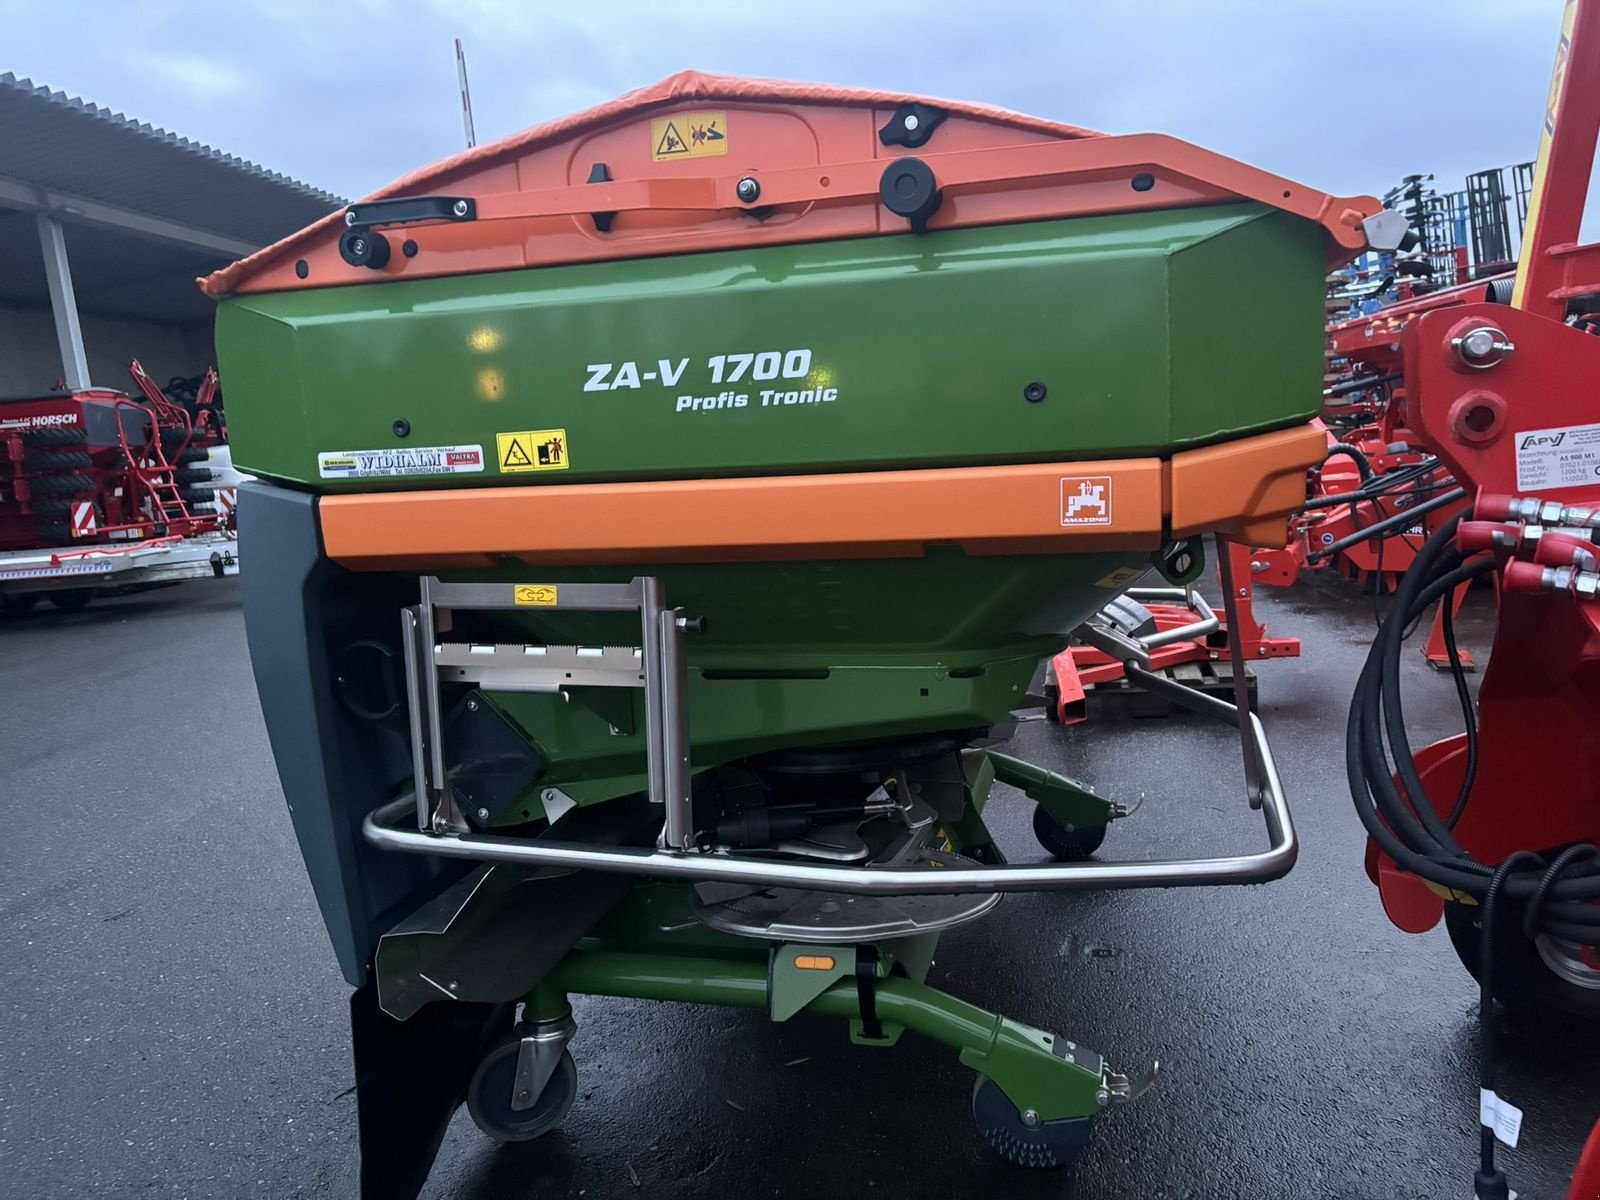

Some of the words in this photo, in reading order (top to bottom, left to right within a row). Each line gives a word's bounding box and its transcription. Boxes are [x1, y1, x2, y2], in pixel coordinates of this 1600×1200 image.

[583, 357, 690, 392] ZA-V
[707, 348, 812, 384] 1700
[676, 391, 748, 412] Profis
[759, 386, 838, 407] Tronic
[32, 413, 77, 426] HORSCH
[1523, 433, 1564, 449] APV
[358, 453, 442, 470] WIDHALM
